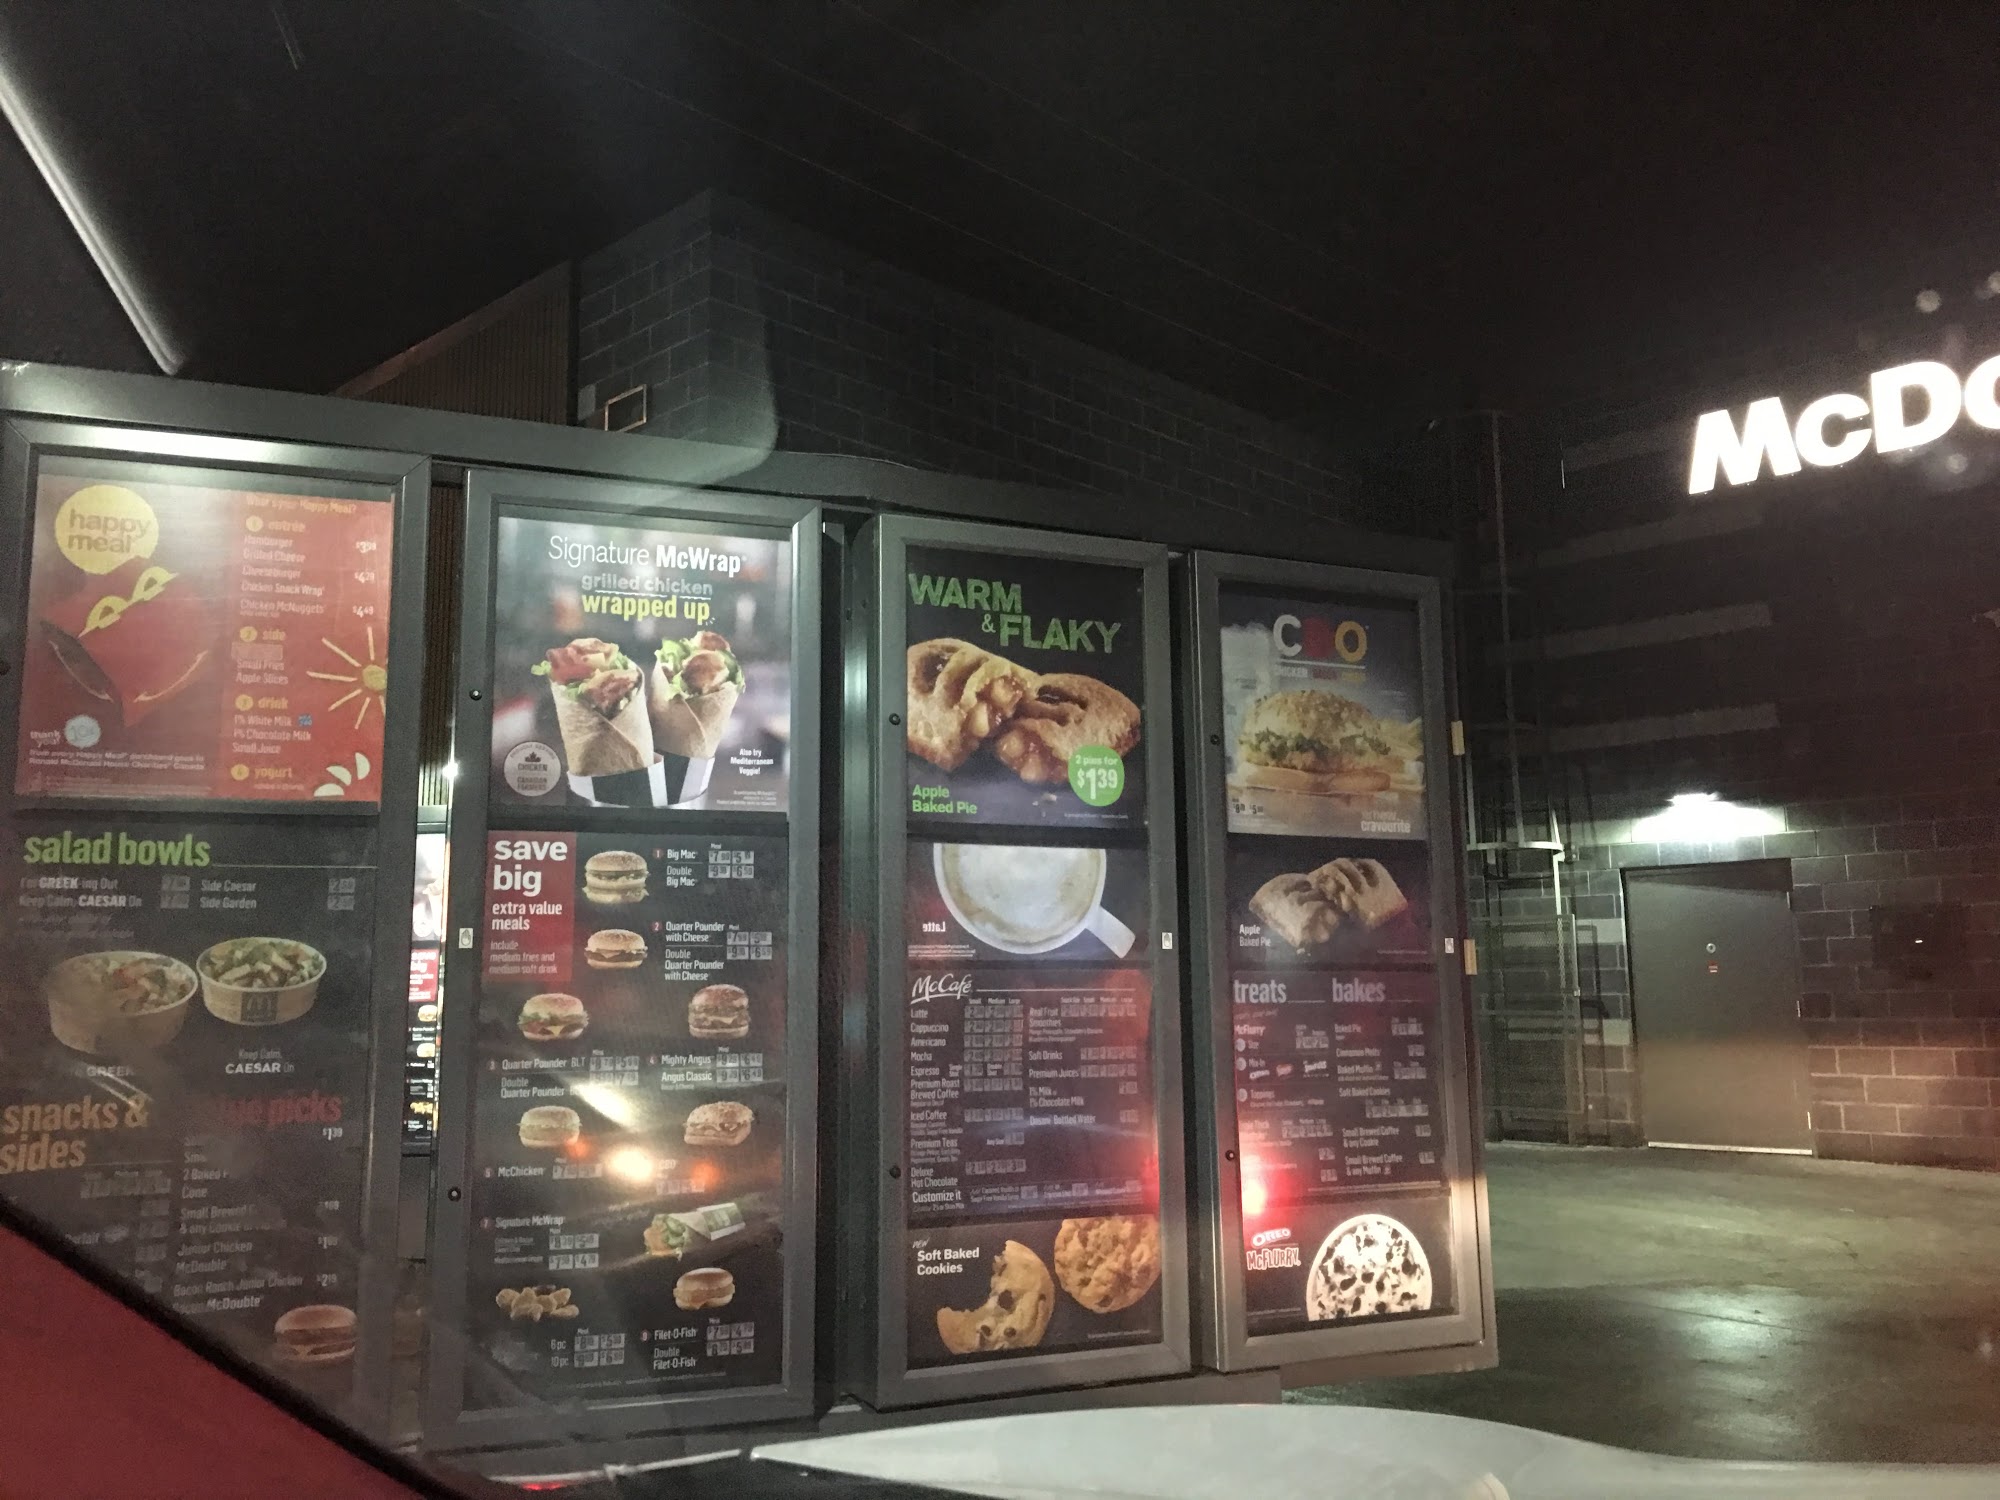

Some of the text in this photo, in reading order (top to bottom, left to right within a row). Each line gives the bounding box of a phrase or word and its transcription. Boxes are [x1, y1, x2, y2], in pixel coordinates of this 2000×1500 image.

[69, 508, 151, 540] happy
[67, 535, 132, 553] meal
[548, 535, 743, 578] Signature McWrap
[581, 573, 713, 596] grilled chicken
[908, 573, 1023, 614] WARM
[581, 594, 710, 625] wrapped up
[981, 613, 1122, 654] & FLAKY
[1273, 614, 1368, 663] CO
[235, 672, 261, 684] Apple
[248, 715, 273, 726] White
[739, 748, 762, 758] Also try
[730, 756, 774, 766] Mediterranean
[1075, 754, 1082, 765] 2
[1104, 756, 1119, 766] for
[254, 768, 292, 779] yogurt
[912, 784, 950, 799] Apple
[912, 800, 978, 814] Baked Pie
[23, 831, 212, 867] salad bowls
[494, 839, 568, 861] save
[666, 848, 696, 860] Big Mac
[666, 865, 692, 876] Double
[201, 879, 257, 892] Side Caesar
[492, 864, 542, 897] big
[666, 877, 697, 888] Big Mac
[78, 895, 127, 907] CAESAR
[200, 897, 257, 909] Side Garden
[492, 900, 563, 915] extra value
[491, 916, 531, 931] meals
[665, 921, 725, 932] Quarter Pounder
[1239, 923, 1261, 936] Apple
[665, 932, 709, 942] with Cheese
[1239, 936, 1260, 947] Baked
[490, 940, 519, 950] include
[522, 951, 540, 962] fries
[541, 952, 555, 962] and
[665, 949, 691, 959] Double
[664, 960, 725, 970] Quarter Pounder
[664, 971, 709, 981] with Cheese
[911, 973, 973, 1003] McCafé
[1233, 977, 1386, 1004] treats bakes
[910, 1009, 929, 1018] Latte
[910, 1022, 949, 1034] Cappuccino
[1029, 1018, 1062, 1027] Smoothies
[910, 1038, 947, 1047] Americano
[661, 1055, 712, 1066] Mighty Angus
[910, 1052, 932, 1061] Mocha
[1029, 1050, 1063, 1061] Soft Drinks
[225, 1062, 281, 1074] CAESAR
[502, 1057, 586, 1071] Quarter Pounder BLT
[661, 1070, 713, 1083] Angus Classic
[910, 1066, 940, 1077] Espresso
[1029, 1068, 1079, 1078] Premium Juices
[501, 1077, 529, 1088] Double
[910, 1078, 960, 1089] Premium Roast
[501, 1086, 565, 1099] Quarter Pounder
[910, 1088, 959, 1099] Brewed Coffee
[1038, 1086, 1052, 1096] Milk
[1038, 1096, 1084, 1107] Chocolate Milk
[3, 1092, 149, 1135] snacks &
[910, 1110, 947, 1121] Iced Coffee
[1077, 1114, 1096, 1124] Water
[910, 1138, 941, 1149] Premium
[0, 1133, 87, 1175] sides
[497, 1166, 545, 1178] McChicken
[910, 1167, 934, 1177] Deluxe
[910, 1177, 958, 1188] Hot Chocolate
[182, 1186, 208, 1199] Cone
[911, 1190, 954, 1204] Customize
[955, 1189, 962, 1201] it
[495, 1214, 563, 1229] Signature McWrap
[1252, 1228, 1292, 1248] OREO
[917, 1246, 980, 1262] Soft Baked
[176, 1259, 228, 1274] McDouble
[916, 1262, 963, 1276] Cookies
[206, 1295, 263, 1310] McDouble
[653, 1328, 697, 1341] Filet-O-Fish
[653, 1347, 681, 1358] Double
[653, 1357, 697, 1371] Filet-O-Fish
